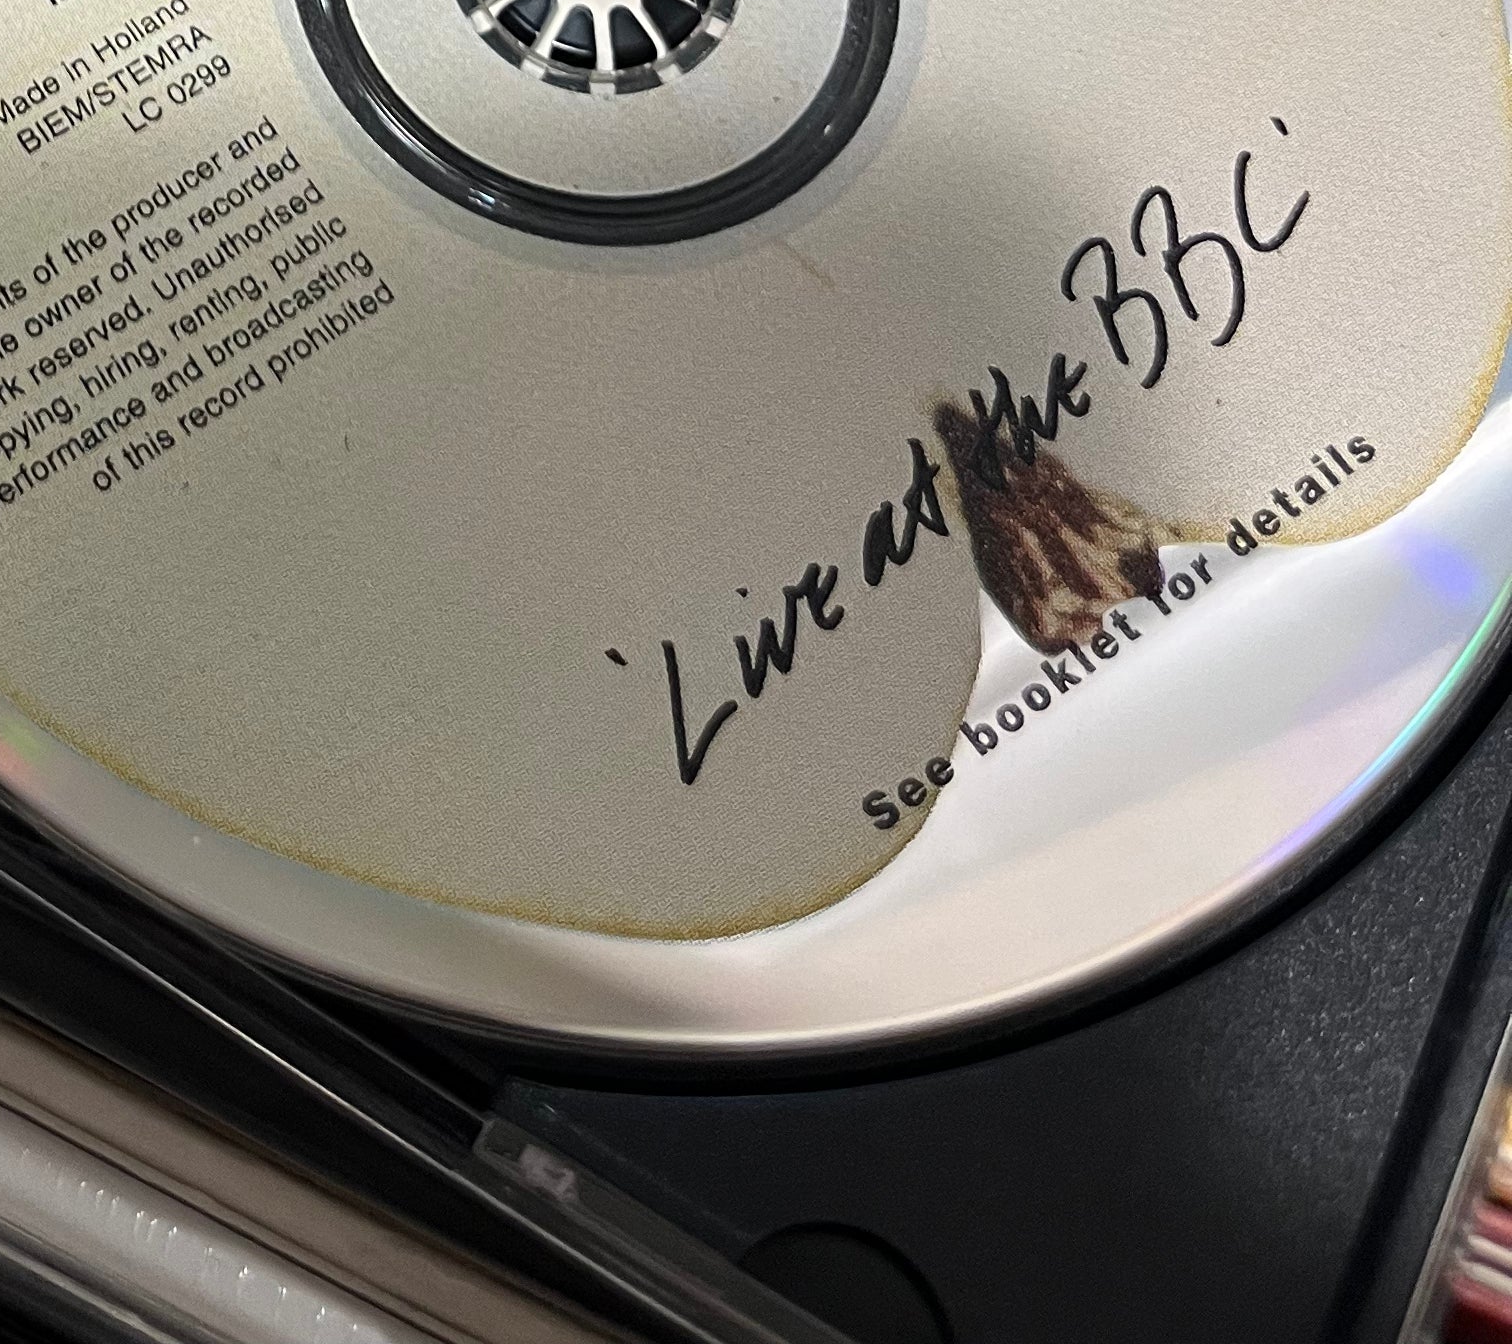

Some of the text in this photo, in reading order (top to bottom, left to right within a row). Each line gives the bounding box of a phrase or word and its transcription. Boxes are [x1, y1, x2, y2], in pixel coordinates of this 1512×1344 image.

[16, 25, 213, 155] BIEM/STEMRA
[60, 57, 92, 83] in
[121, 54, 232, 134] LC 0299
[24, 275, 103, 339] owner
[109, 249, 138, 284] of
[138, 227, 184, 264] the
[187, 146, 301, 234] recorded
[27, 294, 152, 387] reserved.
[150, 178, 325, 302] Unauthorised
[32, 252, 60, 286] of
[61, 229, 108, 266] the
[110, 151, 223, 243] producer
[227, 115, 279, 161] and
[78, 339, 168, 399] hiring,
[168, 273, 273, 342] renting,
[269, 216, 348, 283] public
[92, 278, 395, 493] of this record prohibited
[150, 353, 205, 404] and
[202, 249, 374, 368] broadcasting
[862, 437, 950, 587] at
[968, 352, 1092, 491] the
[862, 756, 955, 830] See
[959, 608, 1143, 755] booklet
[1226, 434, 1377, 557] details
